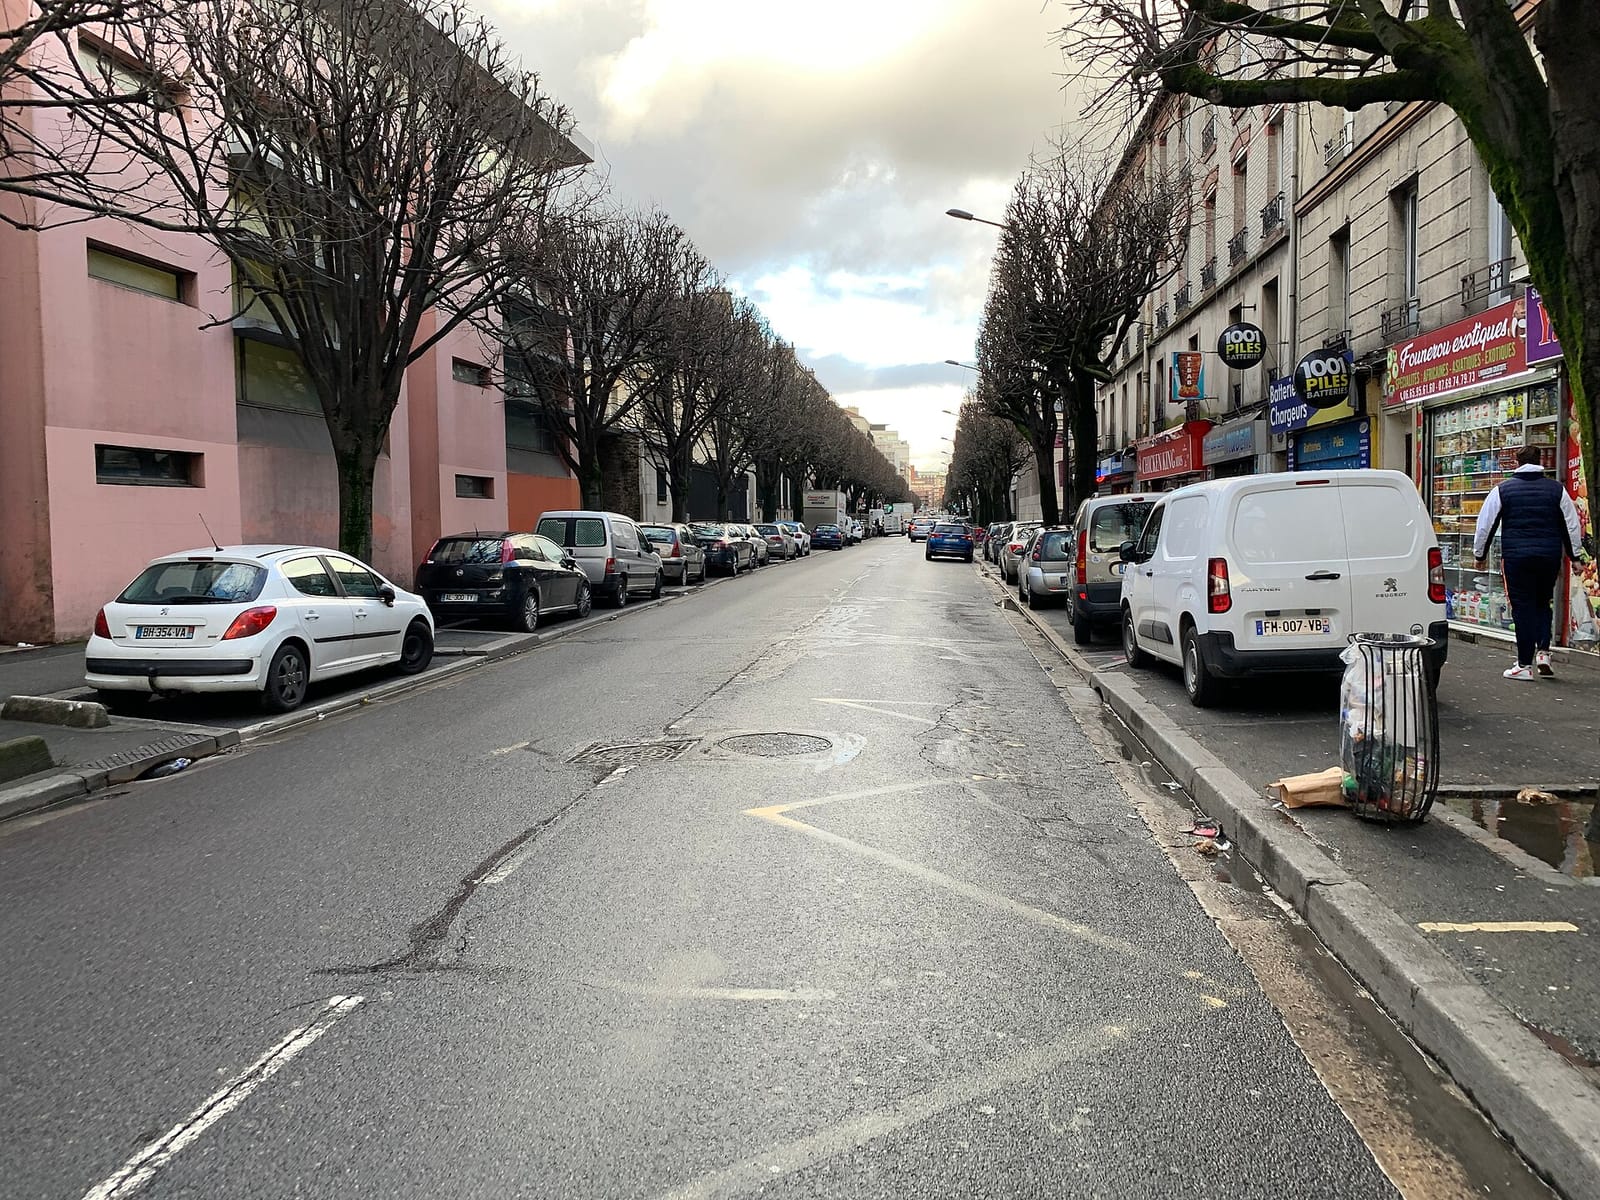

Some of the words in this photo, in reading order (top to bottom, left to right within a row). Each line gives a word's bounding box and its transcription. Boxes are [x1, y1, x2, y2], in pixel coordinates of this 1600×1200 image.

[1224, 329, 1260, 344] 1001
[1225, 341, 1261, 355] PILES
[1226, 352, 1261, 361] BATTERIES
[1484, 341, 1516, 363] EXOTIQUES
[1400, 342, 1451, 373] Founerou
[1300, 356, 1348, 379] 1001
[1270, 377, 1298, 404] Batterie
[1305, 374, 1349, 392] PILES
[1306, 384, 1349, 399] BATTERIES
[1270, 403, 1308, 427] Chargeurs
[1142, 453, 1161, 474] CHICKEN
[1162, 448, 1176, 470] KING
[142, 627, 186, 638] BH-354-VA
[1263, 620, 1323, 634] FH-007-VB
